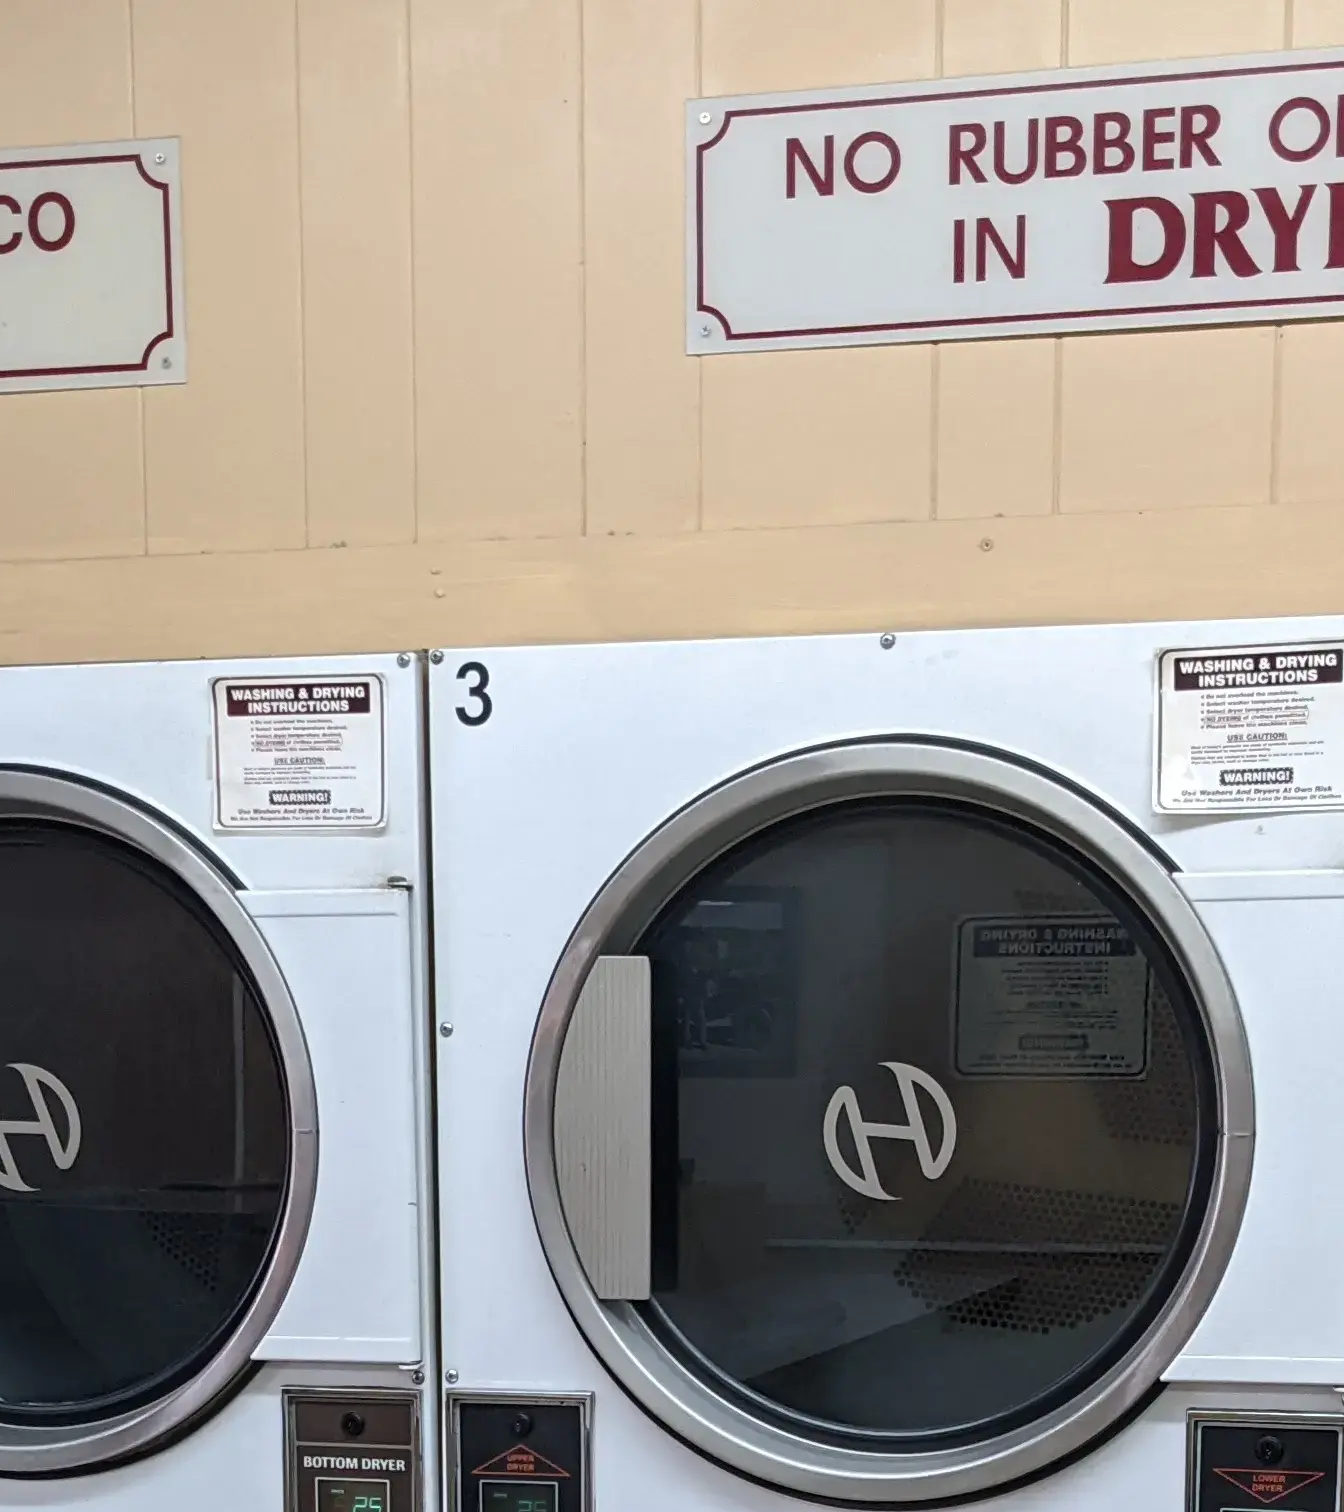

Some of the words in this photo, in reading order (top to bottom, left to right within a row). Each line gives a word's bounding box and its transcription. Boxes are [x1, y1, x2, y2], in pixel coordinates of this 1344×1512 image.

[786, 130, 901, 200] NO
[948, 104, 1222, 186] RUBBER
[952, 215, 1027, 284] IN
[1180, 659, 1253, 674] WASHING
[1258, 658, 1270, 670] &
[1276, 654, 1337, 669] DRYING
[1198, 669, 1318, 688] INSTRUCTIONS
[231, 688, 294, 700] WASHING
[298, 688, 308, 699] &
[313, 686, 365, 699] DRYING
[456, 662, 492, 726] 3
[247, 700, 349, 714] INSTRUCTIONS
[1224, 770, 1290, 783] WARNING!
[272, 793, 328, 803] WARNING!
[1253, 788, 1280, 796] Dryers
[303, 1456, 358, 1470] BOTTOM
[361, 1458, 405, 1472] DRYER
[1252, 1475, 1286, 1484] LOWER
[1252, 1484, 1284, 1493] DRYER
